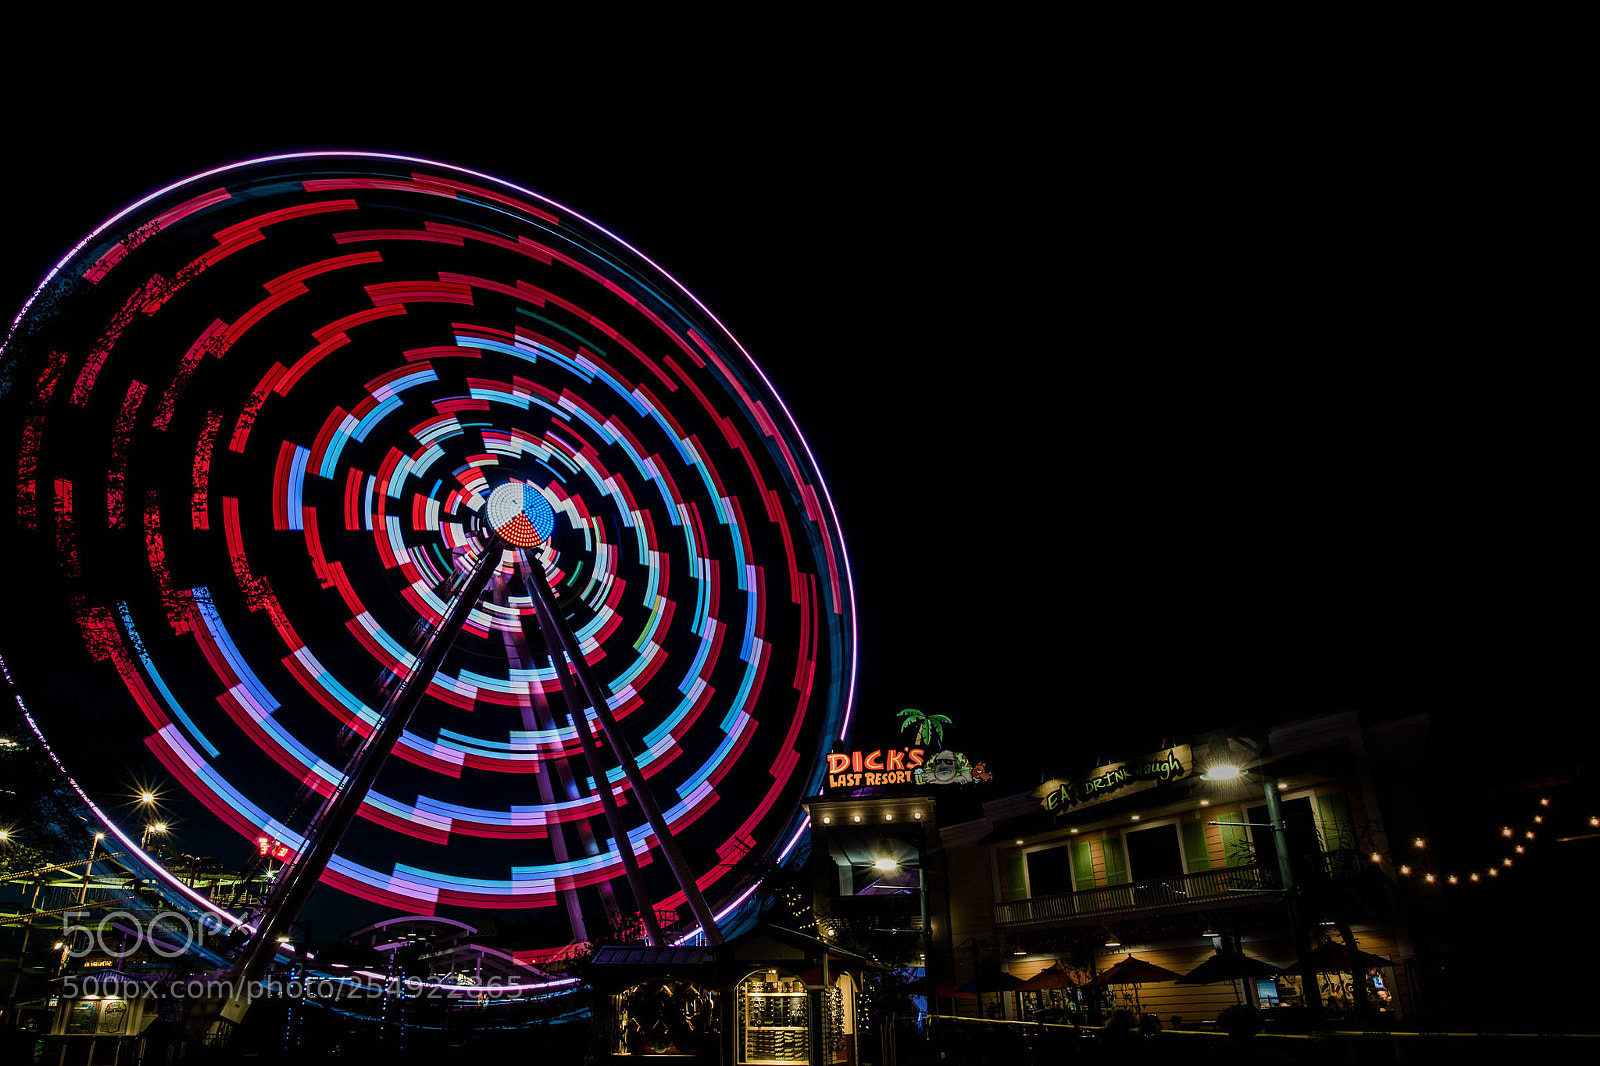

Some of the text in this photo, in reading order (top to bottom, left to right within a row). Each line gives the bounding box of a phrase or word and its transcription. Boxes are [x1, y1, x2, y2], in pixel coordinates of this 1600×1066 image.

[827, 747, 925, 774] DICK'S
[829, 771, 912, 788] LAST RESORT
[1085, 768, 1132, 795] DRINK
